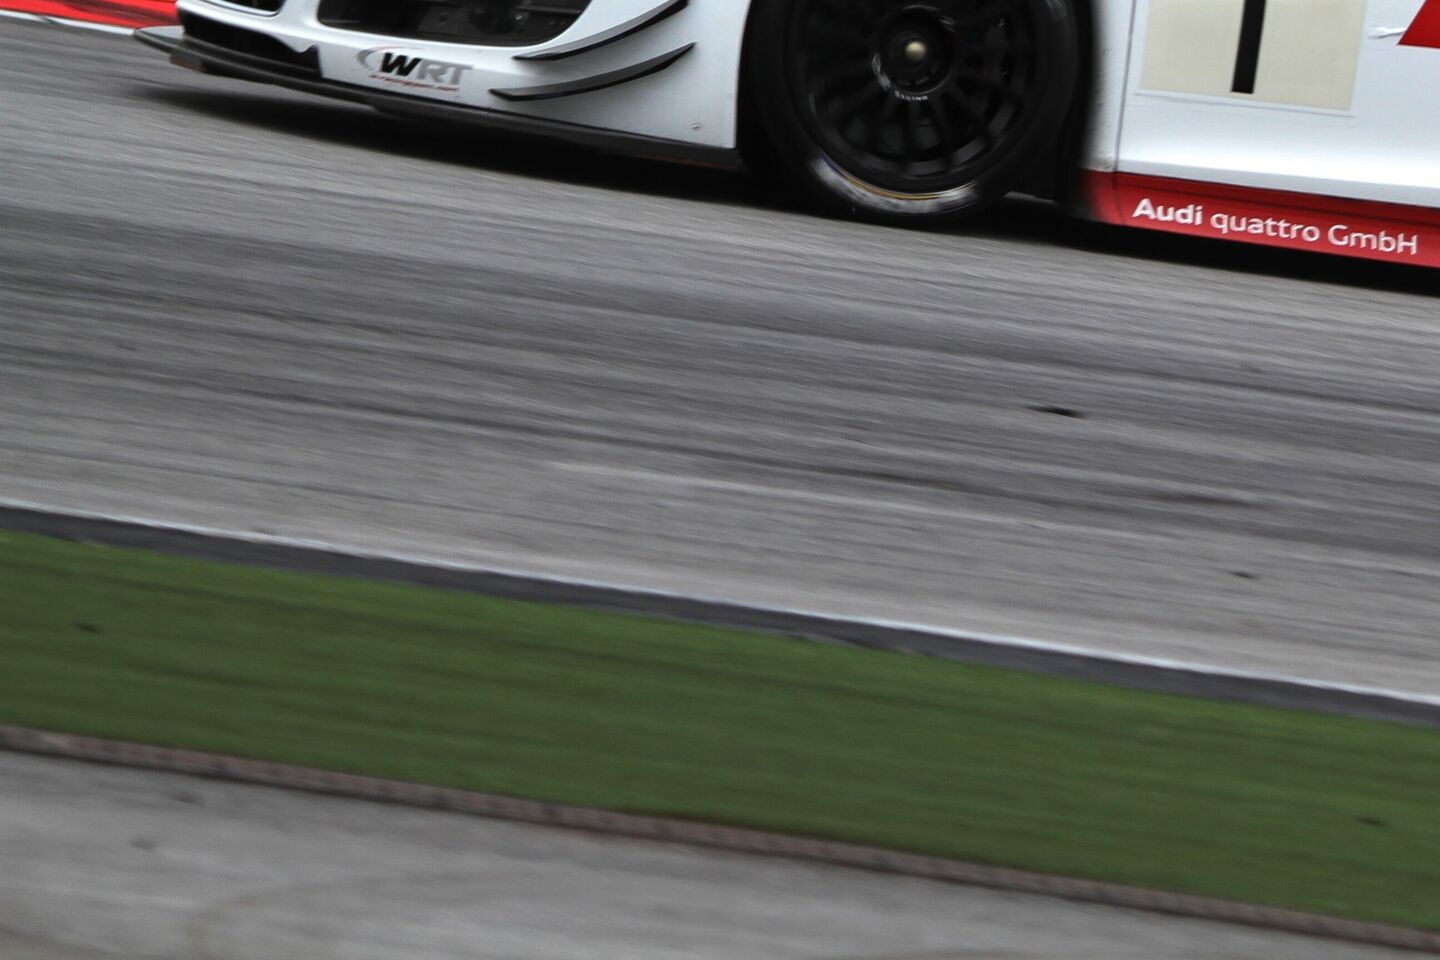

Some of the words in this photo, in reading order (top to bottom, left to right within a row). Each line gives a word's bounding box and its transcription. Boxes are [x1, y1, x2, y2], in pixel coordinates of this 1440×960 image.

[380, 51, 474, 85] WRT
[1131, 198, 1203, 225] Audi
[1209, 212, 1321, 242] quattro
[1327, 224, 1419, 256] GmbH
